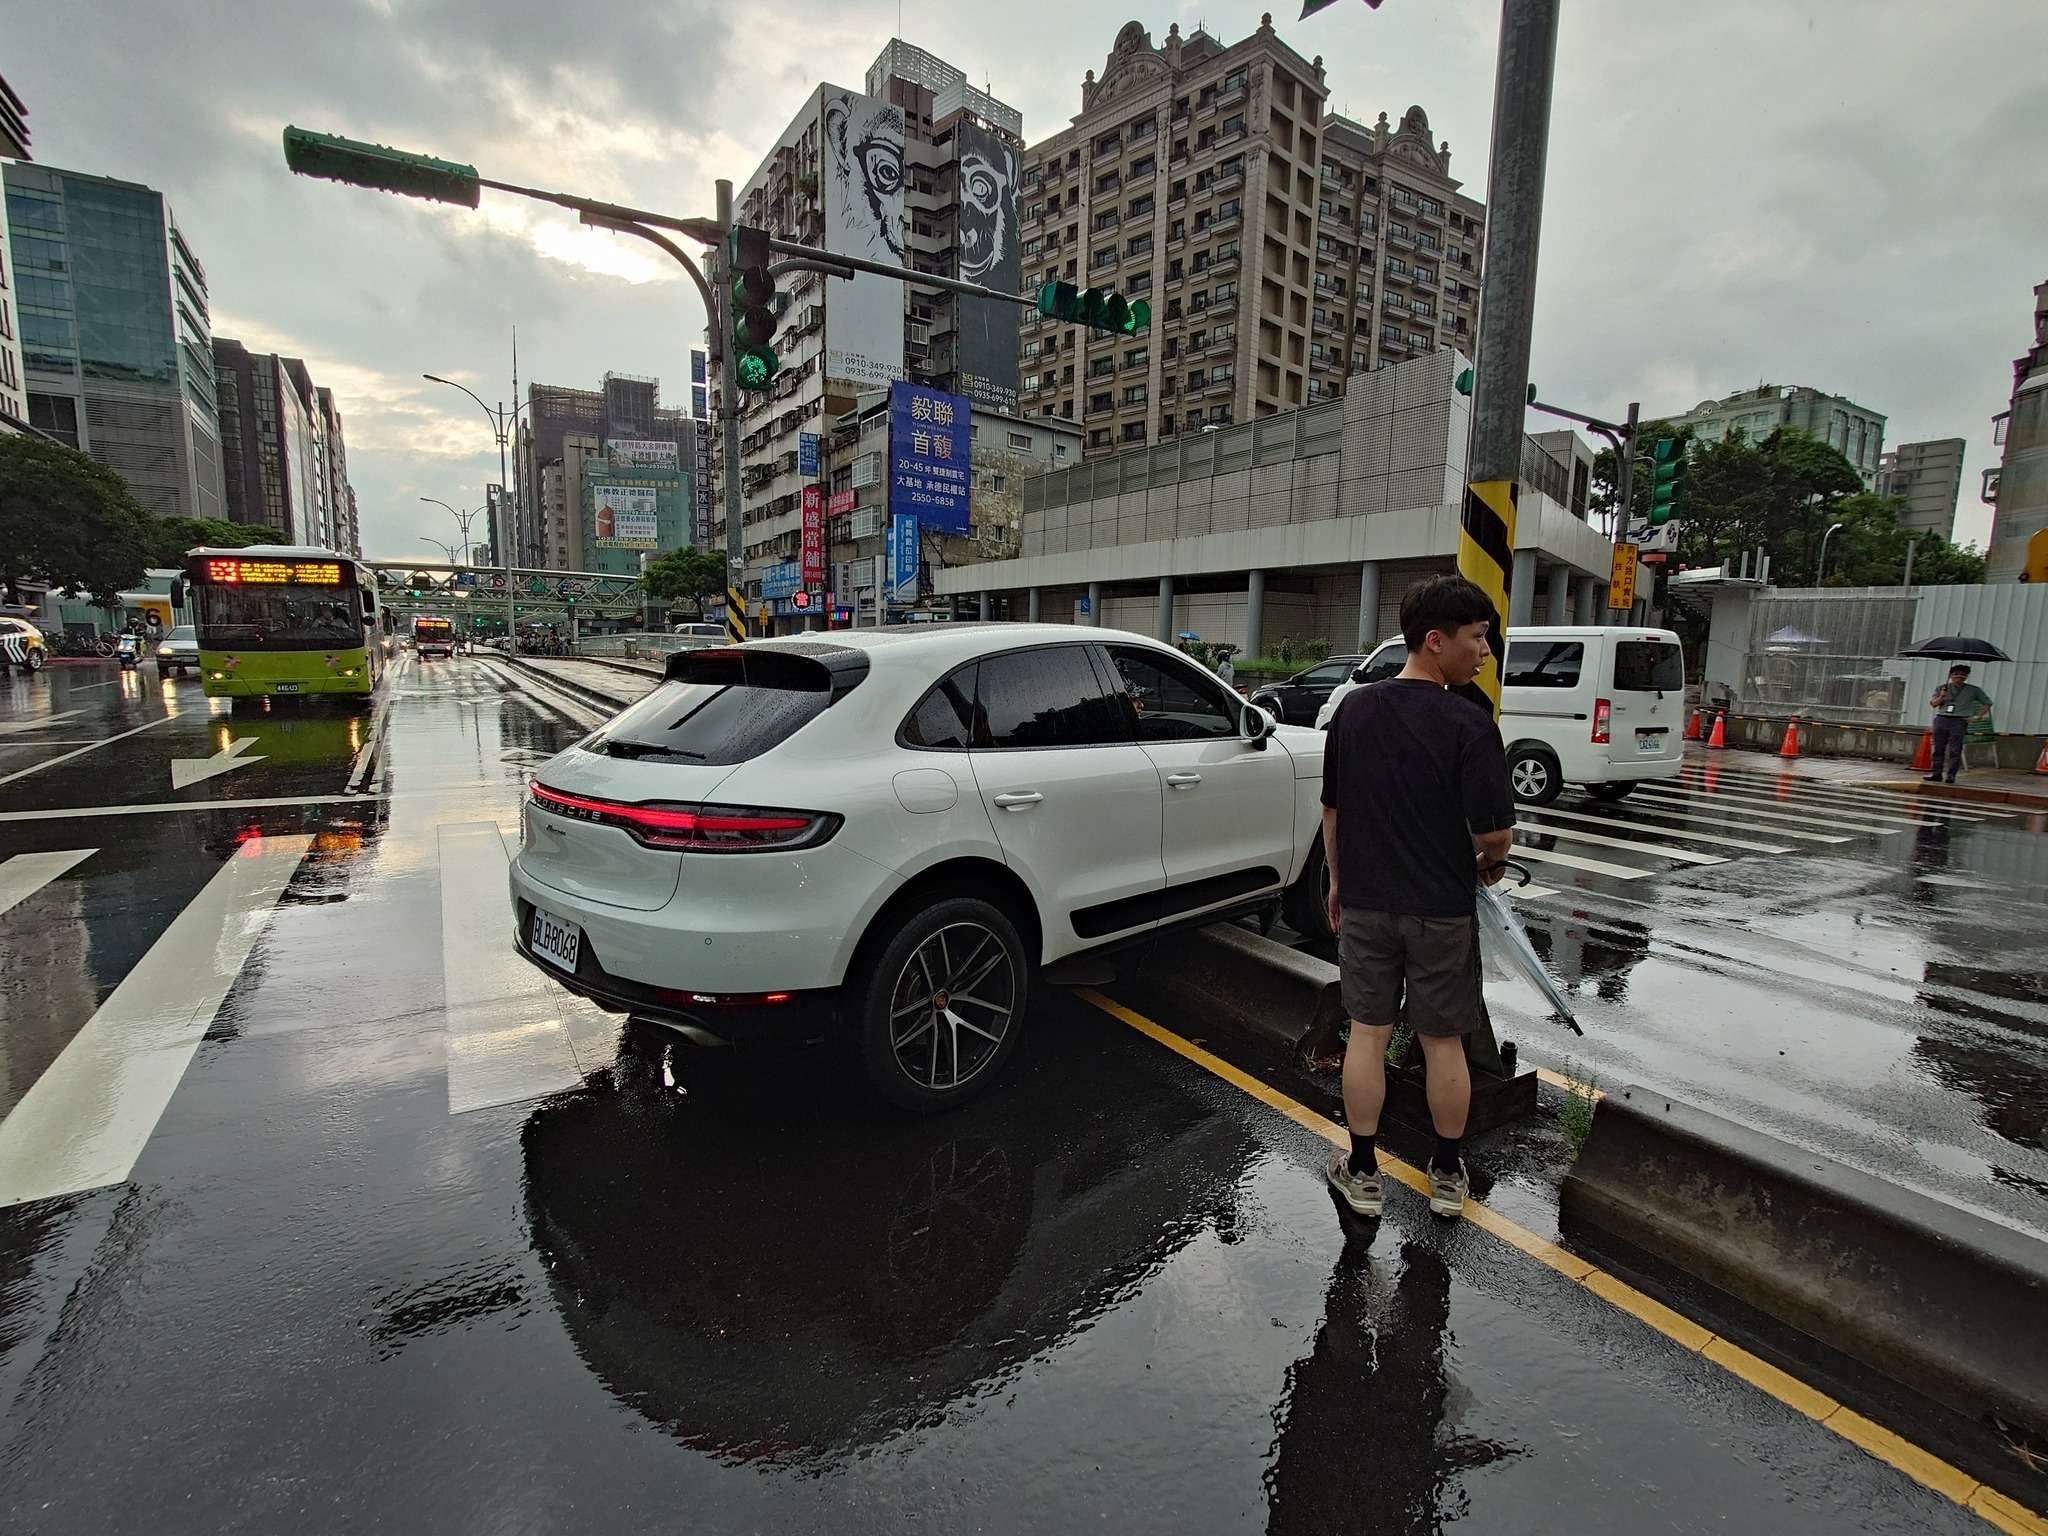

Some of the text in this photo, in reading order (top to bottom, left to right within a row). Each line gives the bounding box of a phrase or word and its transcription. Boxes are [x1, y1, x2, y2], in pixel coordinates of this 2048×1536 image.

[845, 357, 902, 374] 0910-349-930
[974, 380, 1017, 397] 0910-349-930
[974, 389, 1017, 406] 0935-699-610
[911, 395, 953, 426] 毅聯
[911, 430, 953, 460] 首馥
[899, 458, 924, 472] 20-45
[897, 475, 966, 496] 大基地 承德民權站
[912, 492, 954, 507] 2550-6858
[536, 796, 602, 820] PORSCHE
[533, 916, 577, 965] BLB-8068
